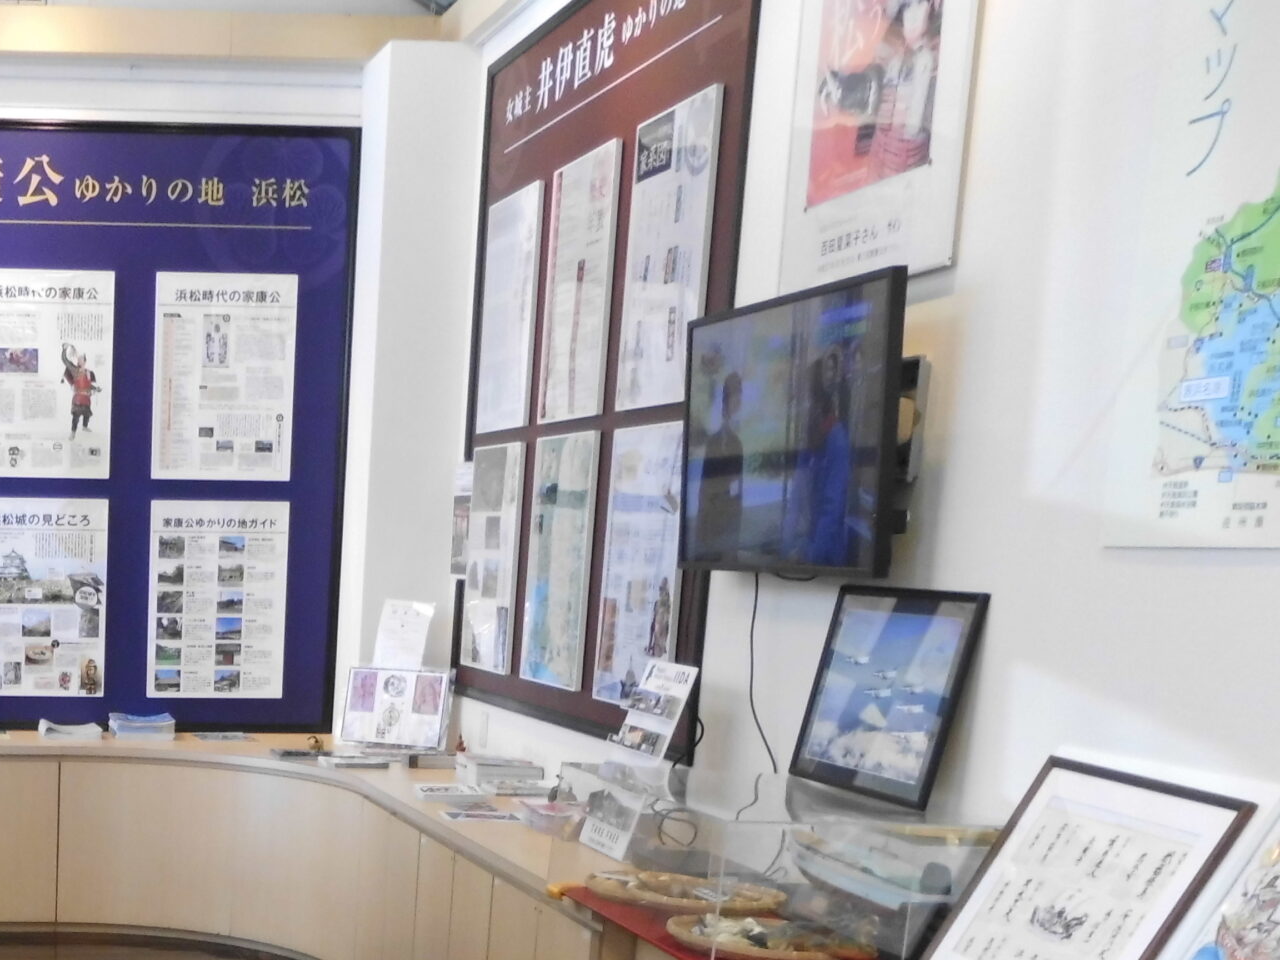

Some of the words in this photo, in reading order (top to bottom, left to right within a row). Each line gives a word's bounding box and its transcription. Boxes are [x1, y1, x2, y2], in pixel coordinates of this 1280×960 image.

[506, 86, 532, 125] 女城主
[536, 13, 616, 114] 井伊直虎
[251, 177, 311, 208] 浜松
[175, 288, 281, 304] 浜松時代の家康公
[162, 517, 278, 530] 家康公ゆかりの地ガイド
